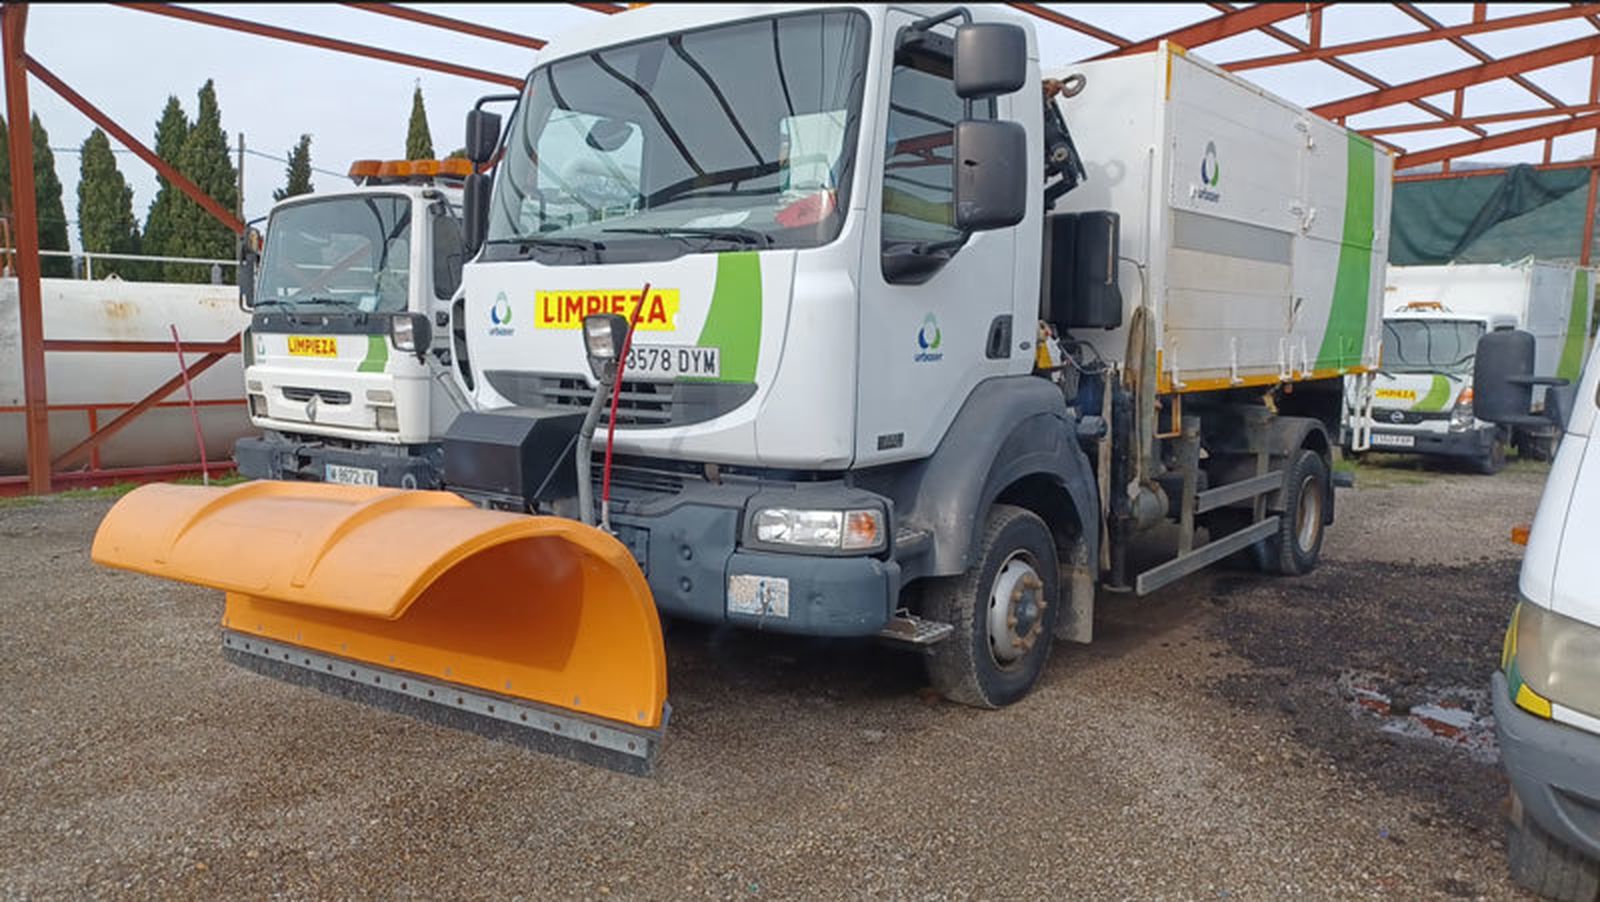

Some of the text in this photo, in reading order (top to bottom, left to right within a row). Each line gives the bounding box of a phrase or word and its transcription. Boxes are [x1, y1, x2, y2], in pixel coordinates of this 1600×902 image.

[543, 295, 667, 324] LIMPIEZA
[289, 338, 337, 355] LIMPIEZA
[679, 351, 716, 374] DYM
